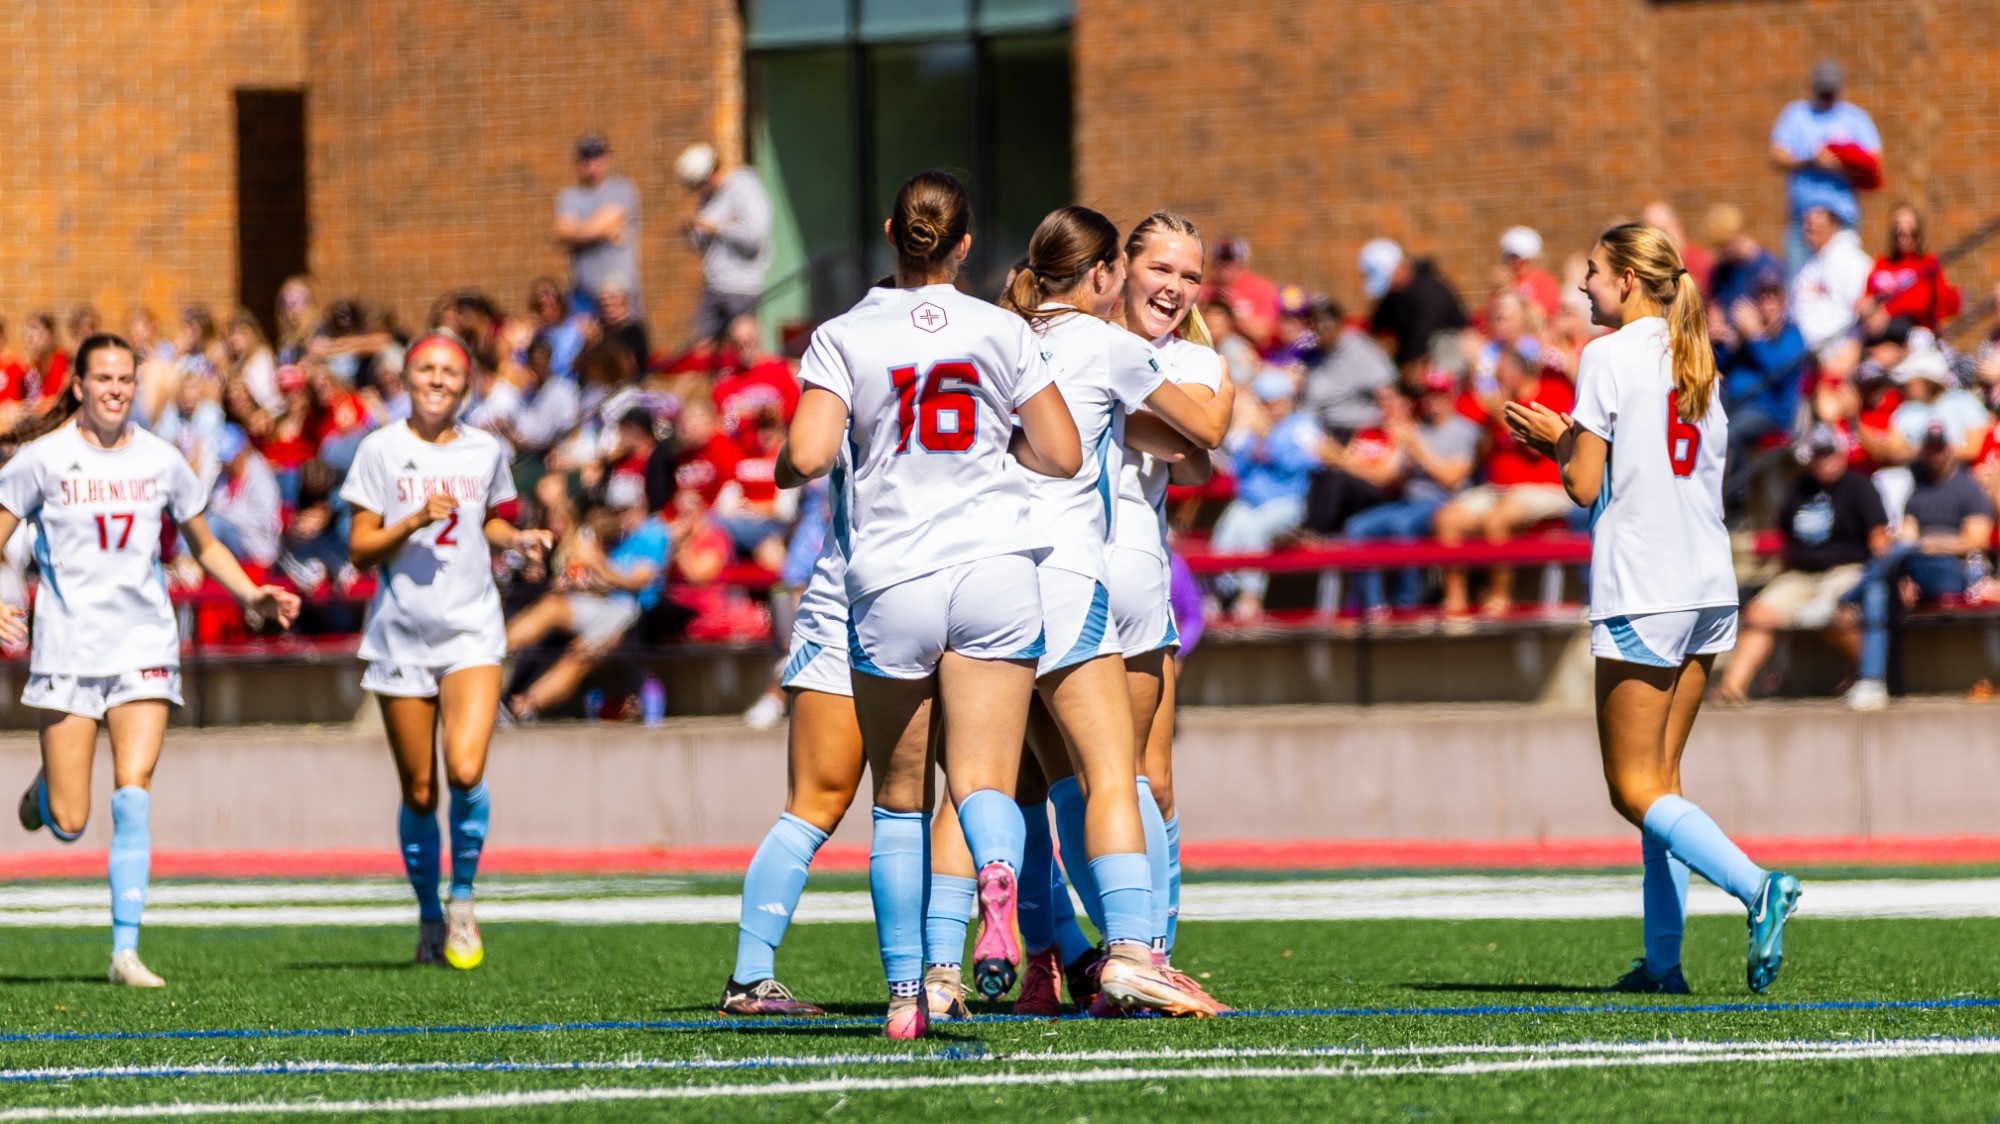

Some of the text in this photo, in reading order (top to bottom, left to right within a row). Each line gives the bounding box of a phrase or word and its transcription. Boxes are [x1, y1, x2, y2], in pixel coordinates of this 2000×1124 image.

[886, 358, 983, 457] 16
[1666, 385, 1703, 480] 6
[94, 513, 135, 551] 17
[435, 511, 458, 546] 2
